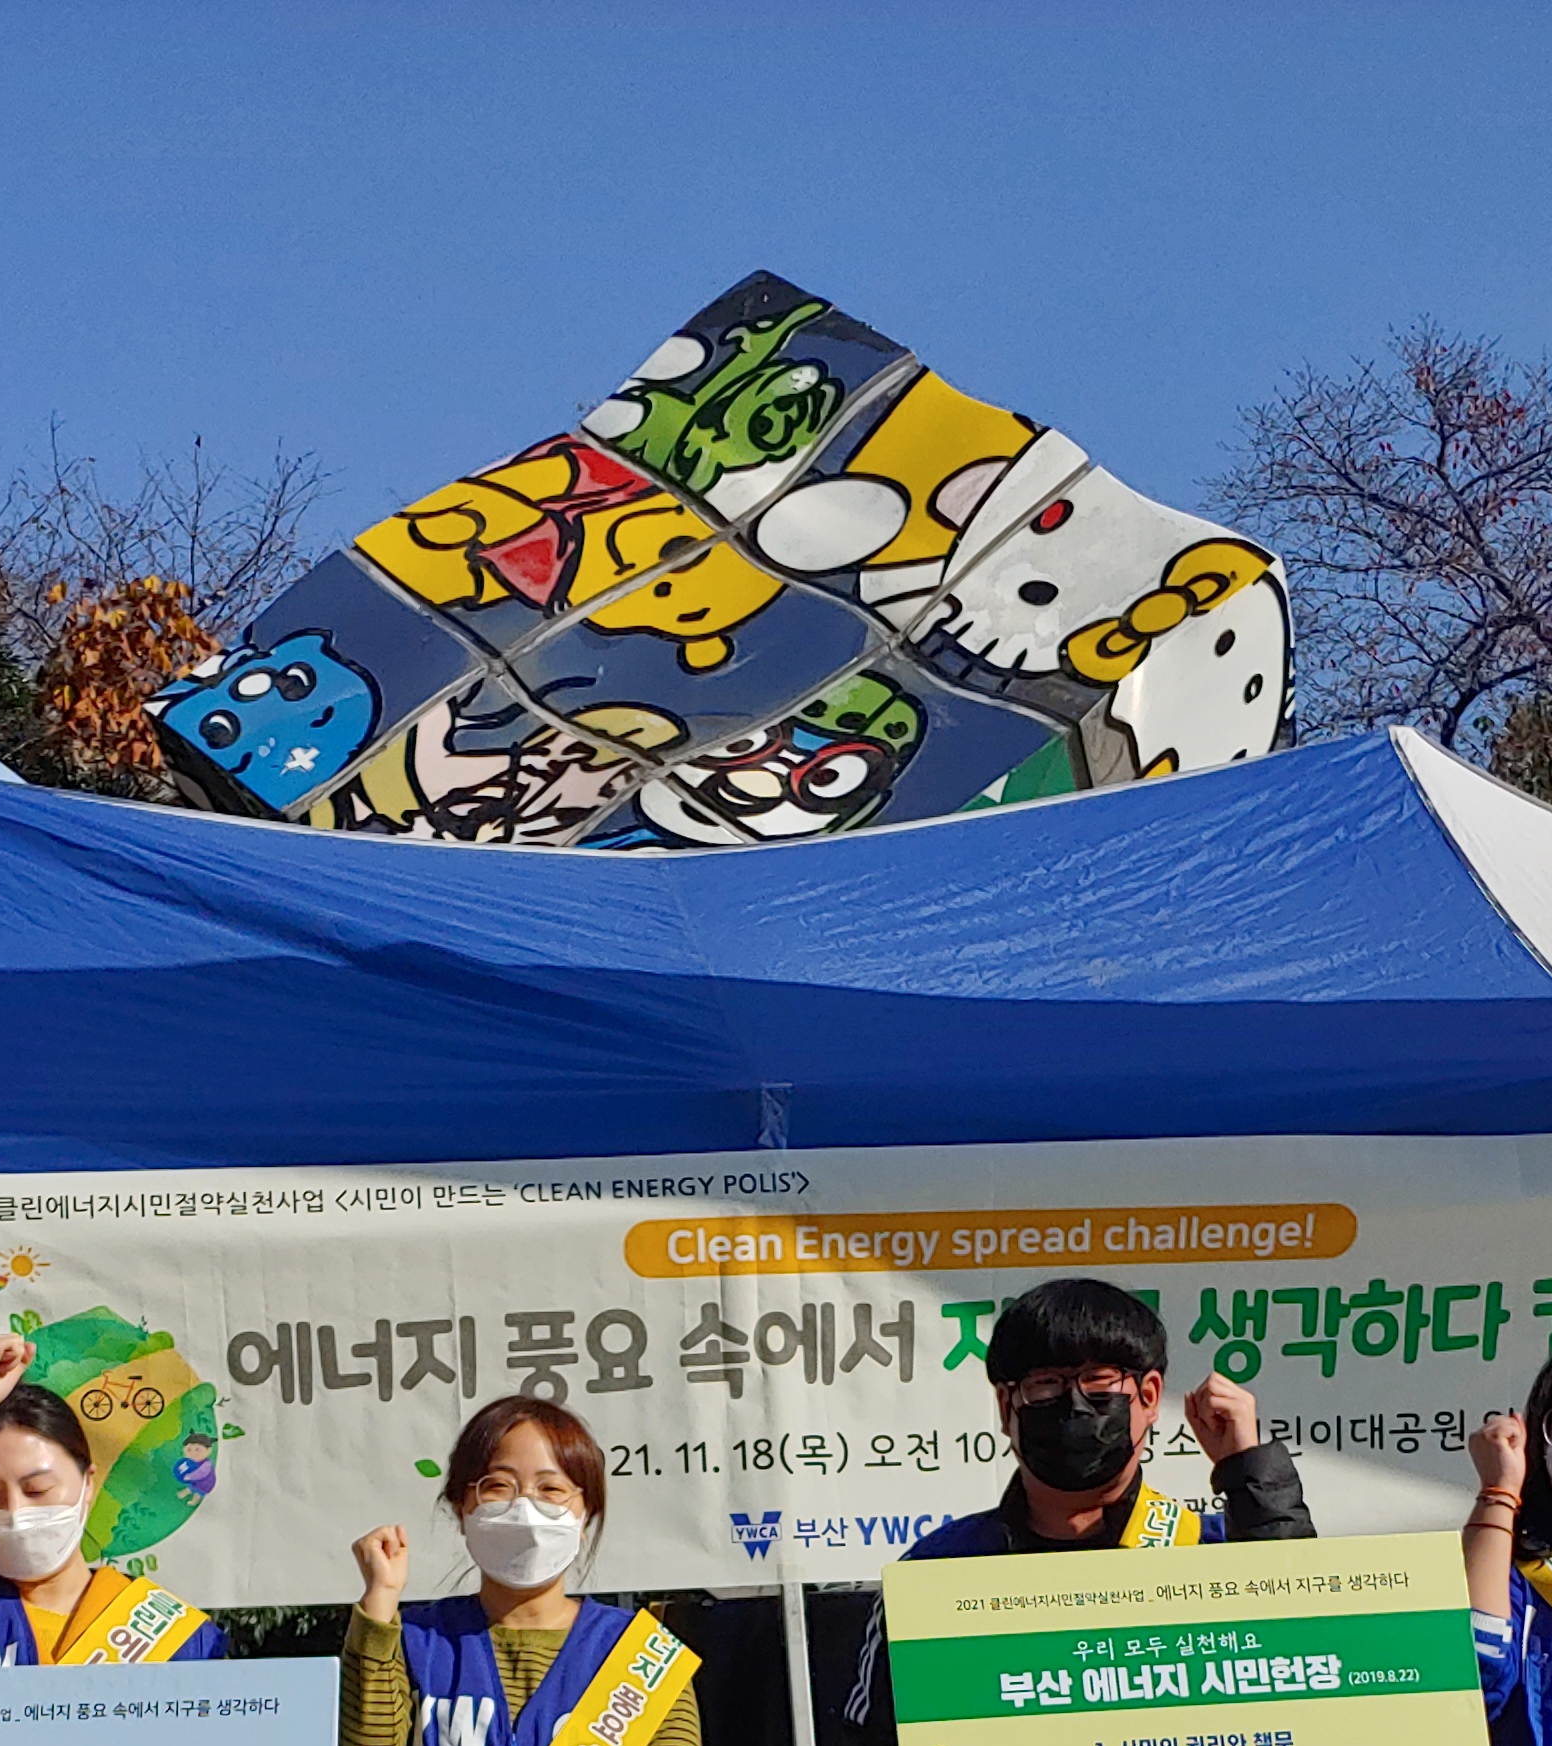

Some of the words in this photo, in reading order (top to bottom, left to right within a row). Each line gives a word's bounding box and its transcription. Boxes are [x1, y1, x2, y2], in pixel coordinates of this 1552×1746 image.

[434, 1184, 505, 1207] 만드는
[612, 1176, 714, 1198] ENERGY
[668, 1228, 782, 1271] Clean
[795, 1220, 941, 1267] Energy
[951, 1219, 1092, 1264] spread
[1104, 1211, 1317, 1255] challenge!
[227, 1316, 476, 1405] 에너지
[504, 1309, 654, 1402] 풍요
[678, 1300, 915, 1399] 속에서
[1191, 1279, 1510, 1383] 생각하다
[675, 1442, 719, 1473] 11.
[865, 1430, 939, 1471] 오전
[1256, 1413, 1467, 1457] 린이대공원
[734, 1524, 780, 1543] YWCA
[793, 1518, 848, 1548] 부산
[1073, 1638, 1114, 1662] 우리
[1125, 1637, 1167, 1658] 모두
[1176, 1631, 1262, 1656] 실천해요
[1000, 1670, 1072, 1707] 부산
[1082, 1663, 1189, 1701] 에너지
[1200, 1655, 1341, 1694] 시민헌장
[1349, 1669, 1419, 1685] (2019.8.22)
